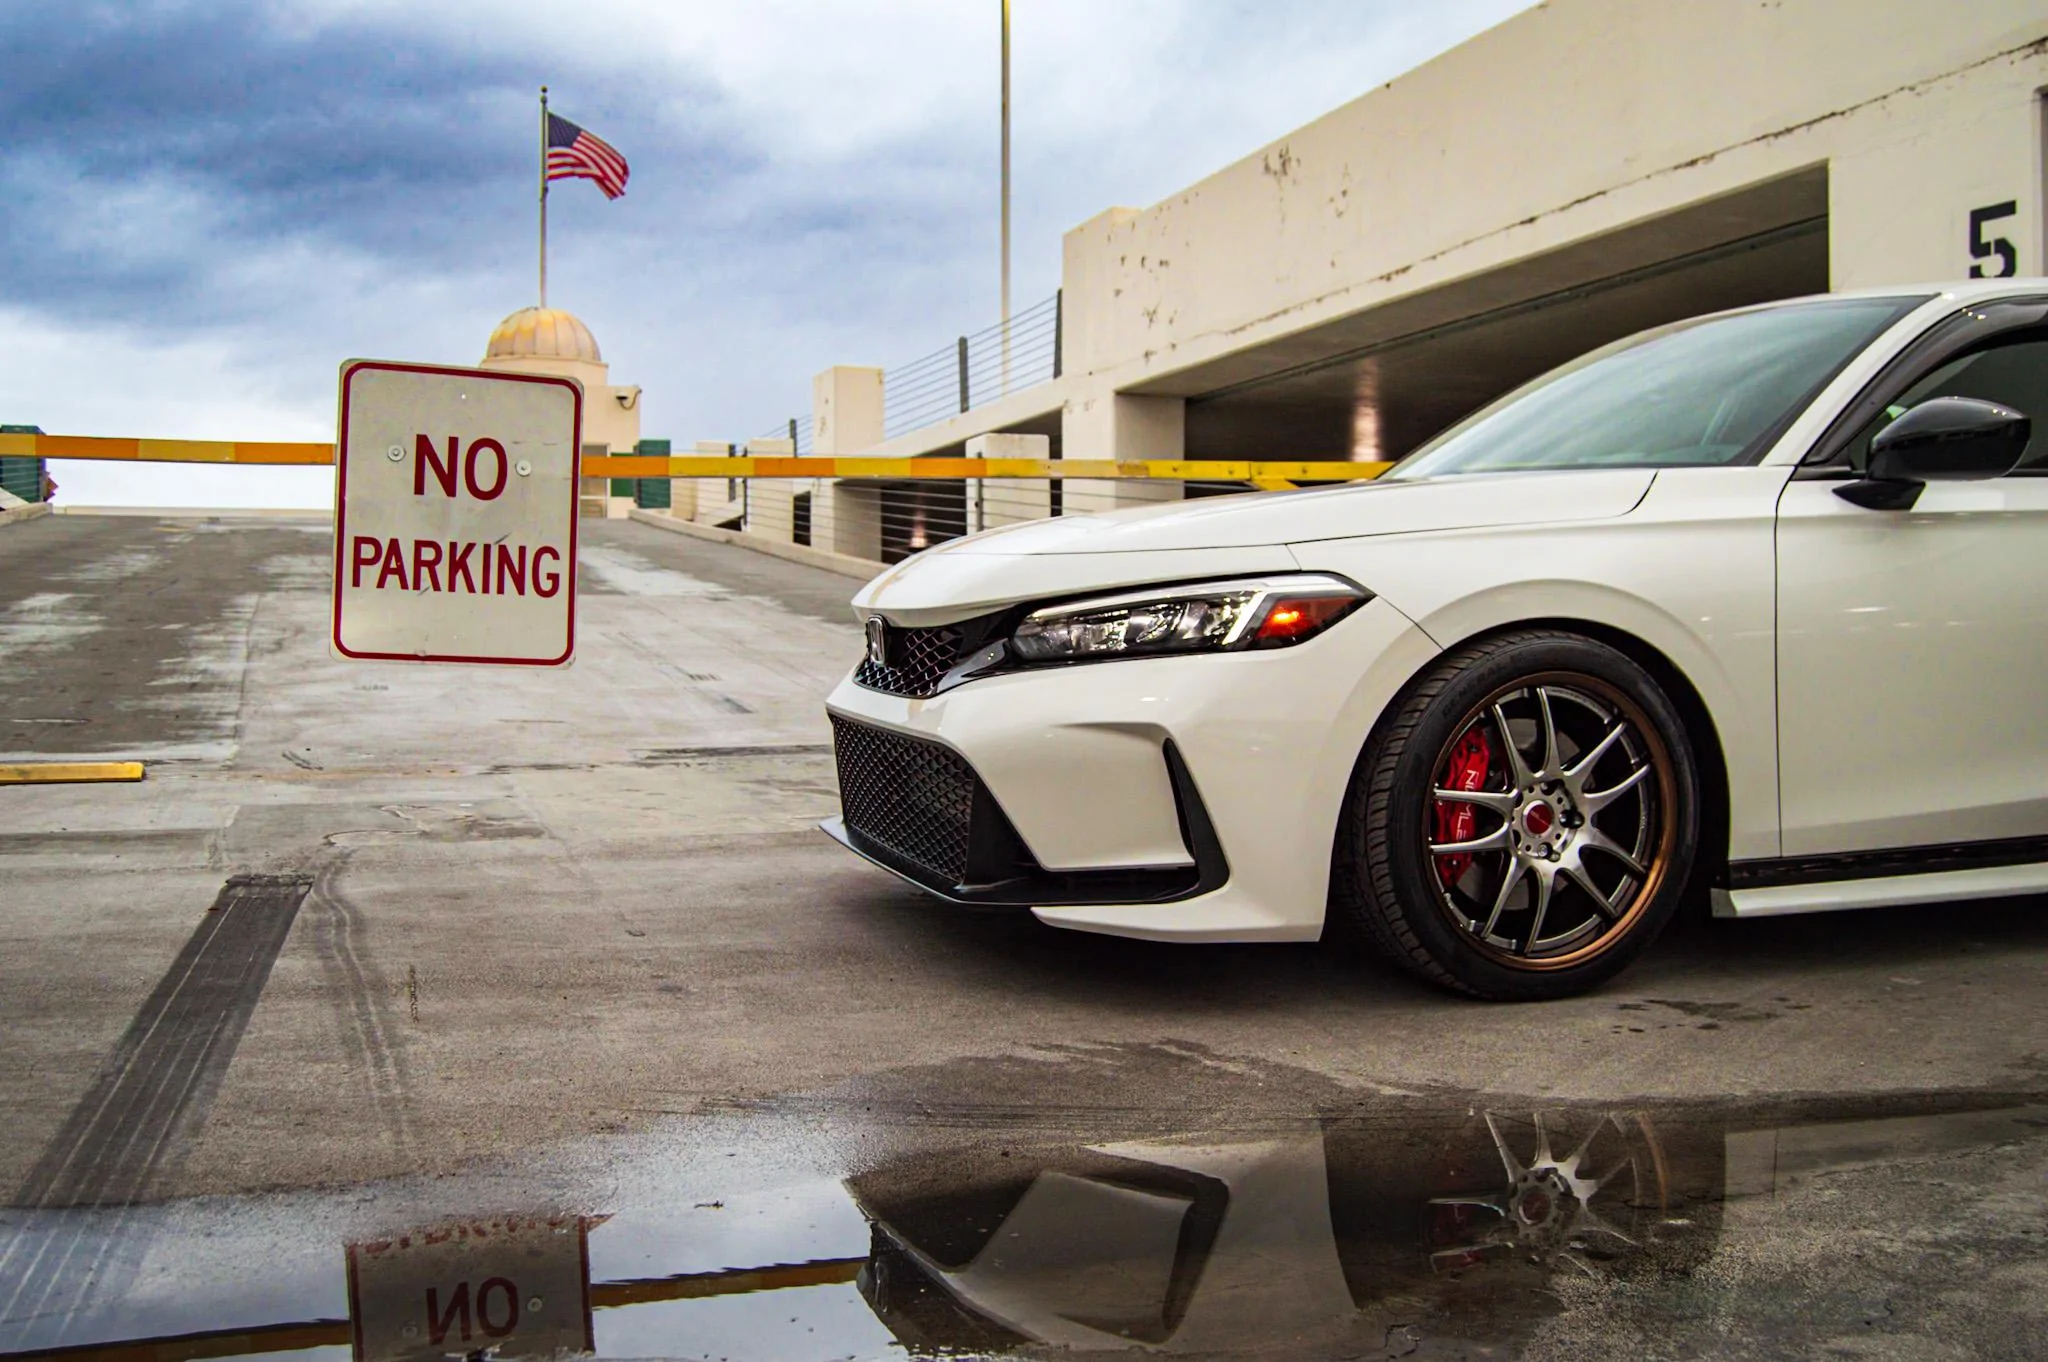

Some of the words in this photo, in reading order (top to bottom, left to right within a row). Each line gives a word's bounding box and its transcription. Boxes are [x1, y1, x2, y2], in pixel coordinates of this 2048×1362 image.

[1969, 200, 2016, 279] 5
[414, 434, 508, 501] NO
[352, 536, 560, 598] PARKING
